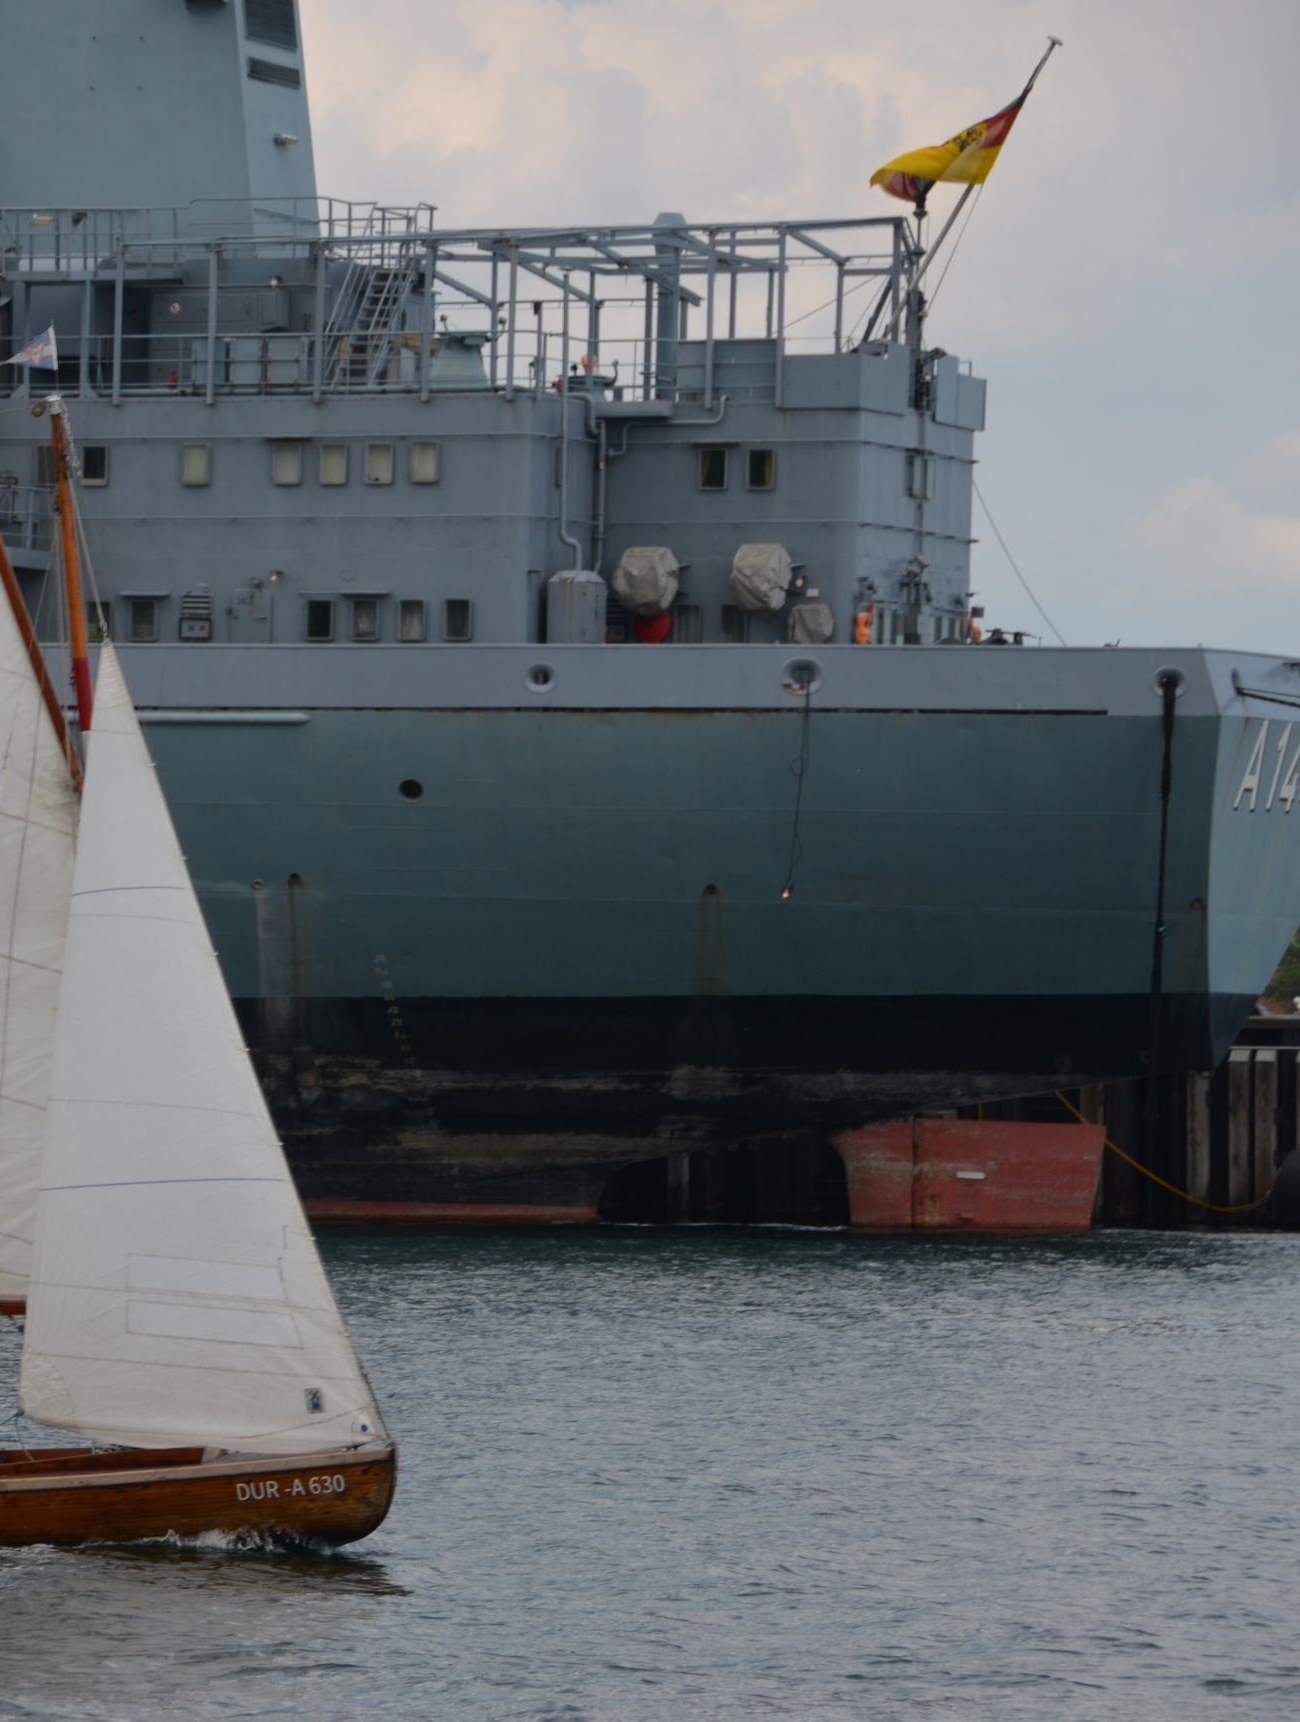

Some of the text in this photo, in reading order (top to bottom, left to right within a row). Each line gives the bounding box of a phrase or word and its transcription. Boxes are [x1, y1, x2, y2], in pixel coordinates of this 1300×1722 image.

[1232, 719, 1300, 812] A14
[235, 1480, 280, 1501] DUR
[308, 1474, 346, 1494] 630
